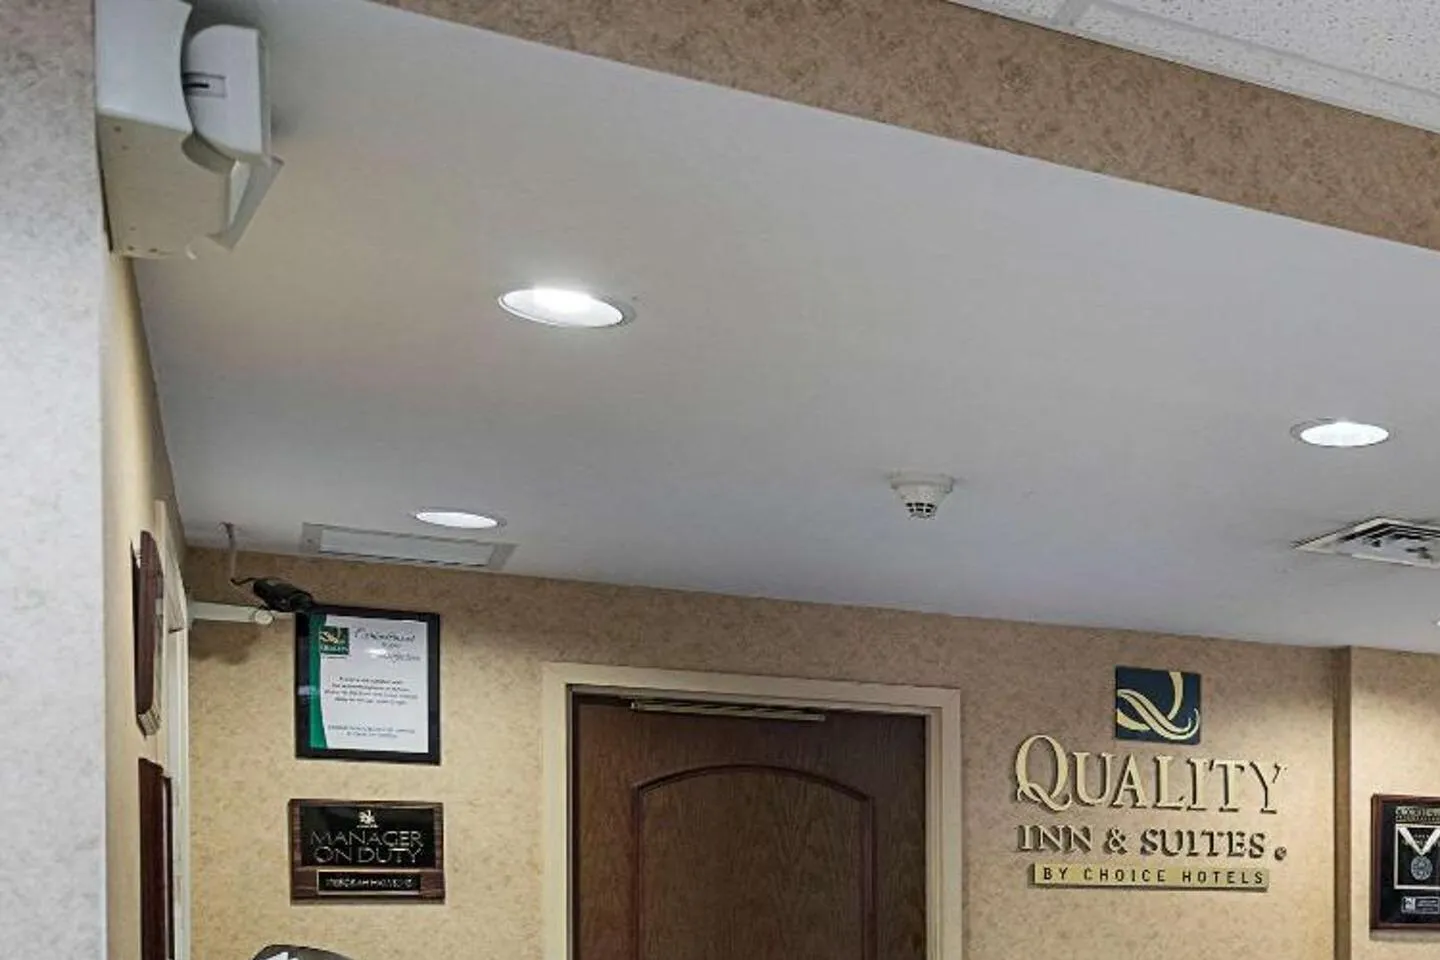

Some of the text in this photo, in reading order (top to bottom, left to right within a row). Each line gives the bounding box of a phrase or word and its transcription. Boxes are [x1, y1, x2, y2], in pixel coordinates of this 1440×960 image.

[1014, 734, 1287, 814] QUALITY
[309, 830, 424, 848] MANAGER
[1017, 824, 1267, 860] INN & SUITES
[313, 846, 425, 864] ON DUTY
[1043, 867, 1264, 885] BY CHOICE HOTELS
